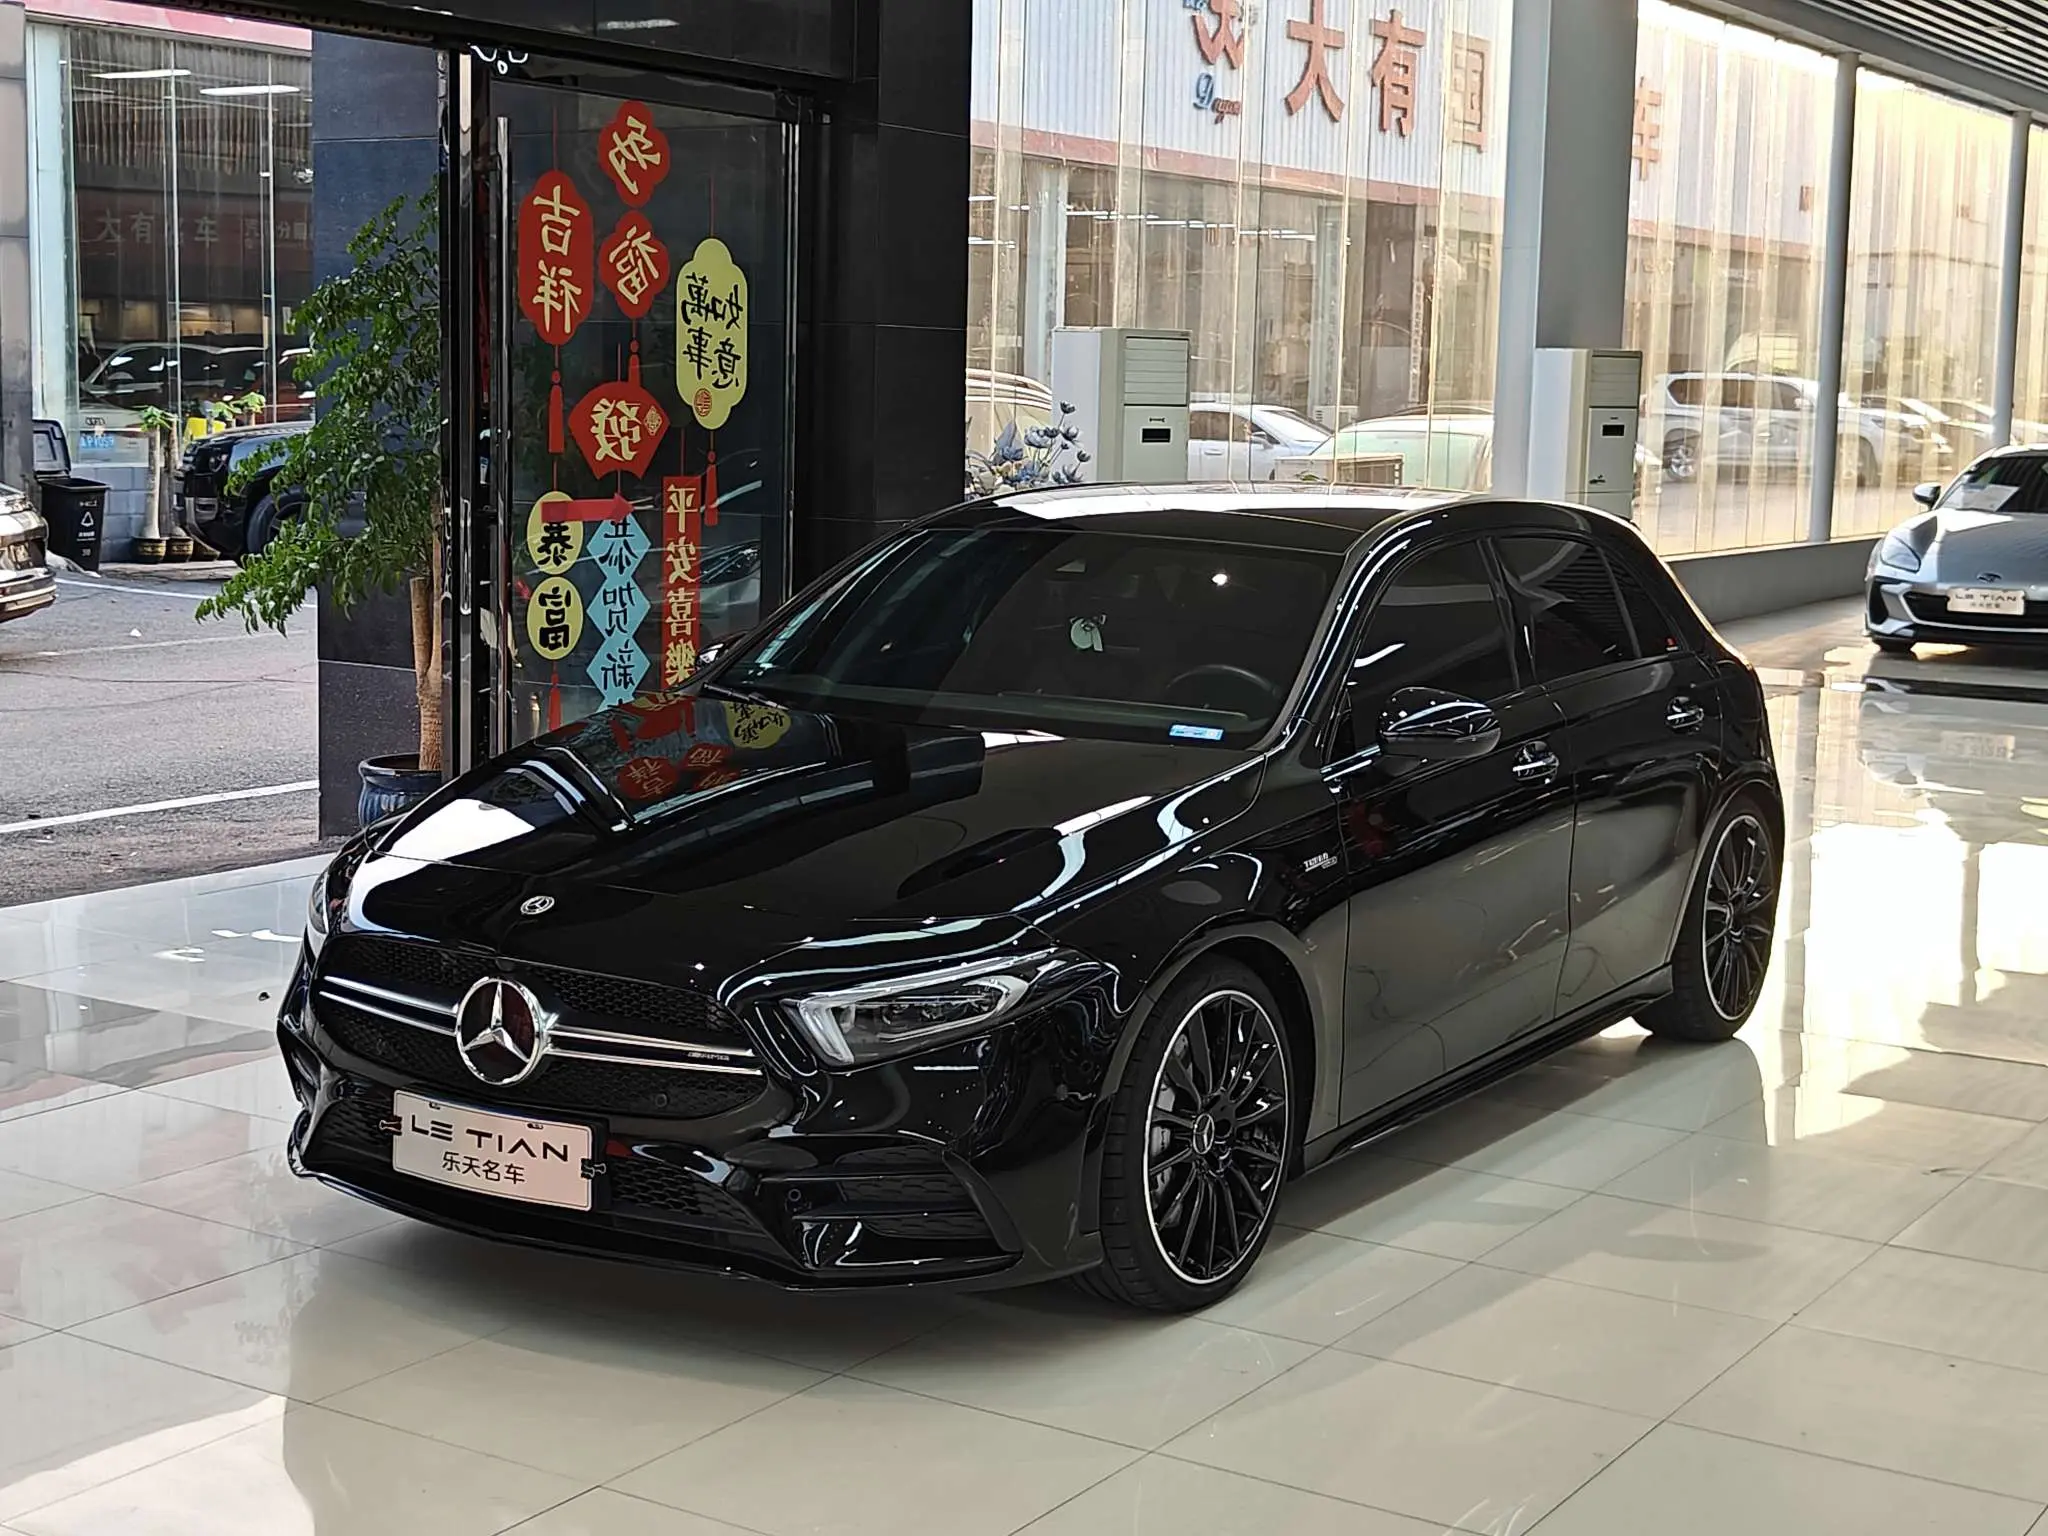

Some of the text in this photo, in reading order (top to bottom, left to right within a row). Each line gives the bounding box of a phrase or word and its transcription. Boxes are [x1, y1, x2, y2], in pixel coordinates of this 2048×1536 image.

[1980, 594, 2017, 602] TIAN
[411, 1114, 569, 1163] LE TIAN
[441, 1151, 526, 1185] 乐天名车
